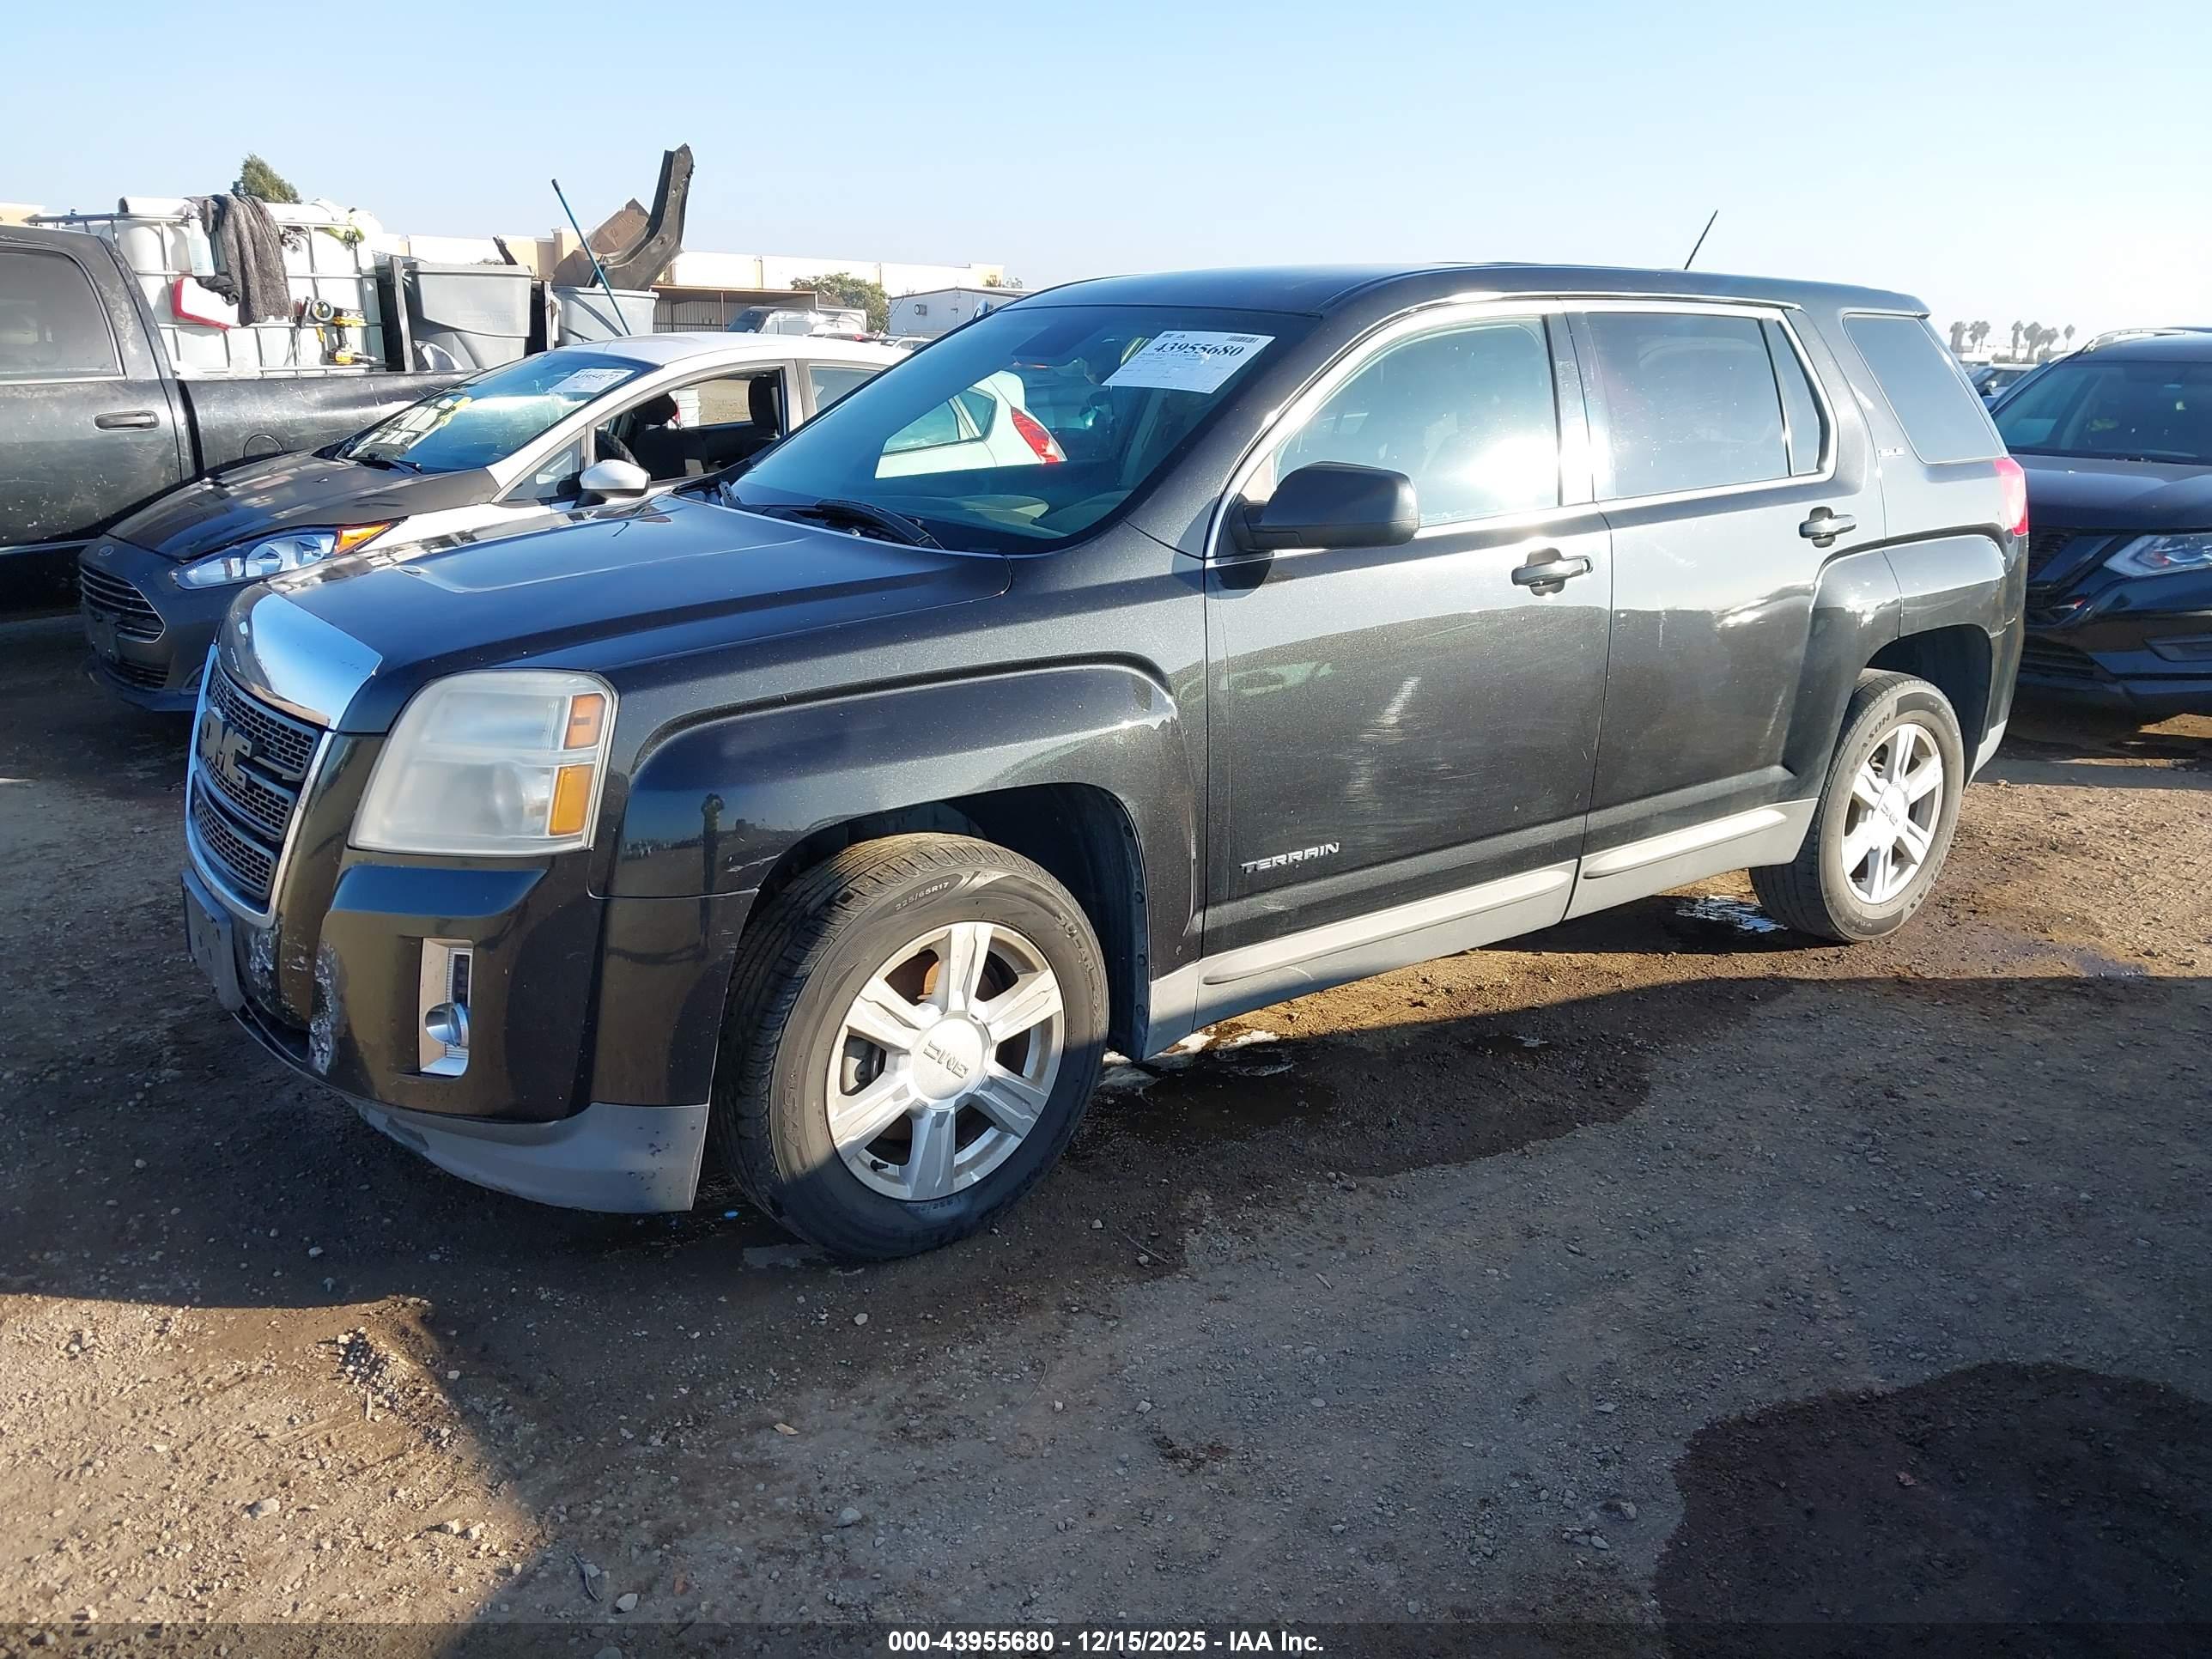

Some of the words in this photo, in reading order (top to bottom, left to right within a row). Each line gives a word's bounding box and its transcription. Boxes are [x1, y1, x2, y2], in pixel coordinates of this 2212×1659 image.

[1154, 342, 1245, 357] 43955680
[1239, 842, 1340, 874] TERRAIN
[895, 882, 950, 911] 225/65R17
[923, 1040, 969, 1079] GMC
